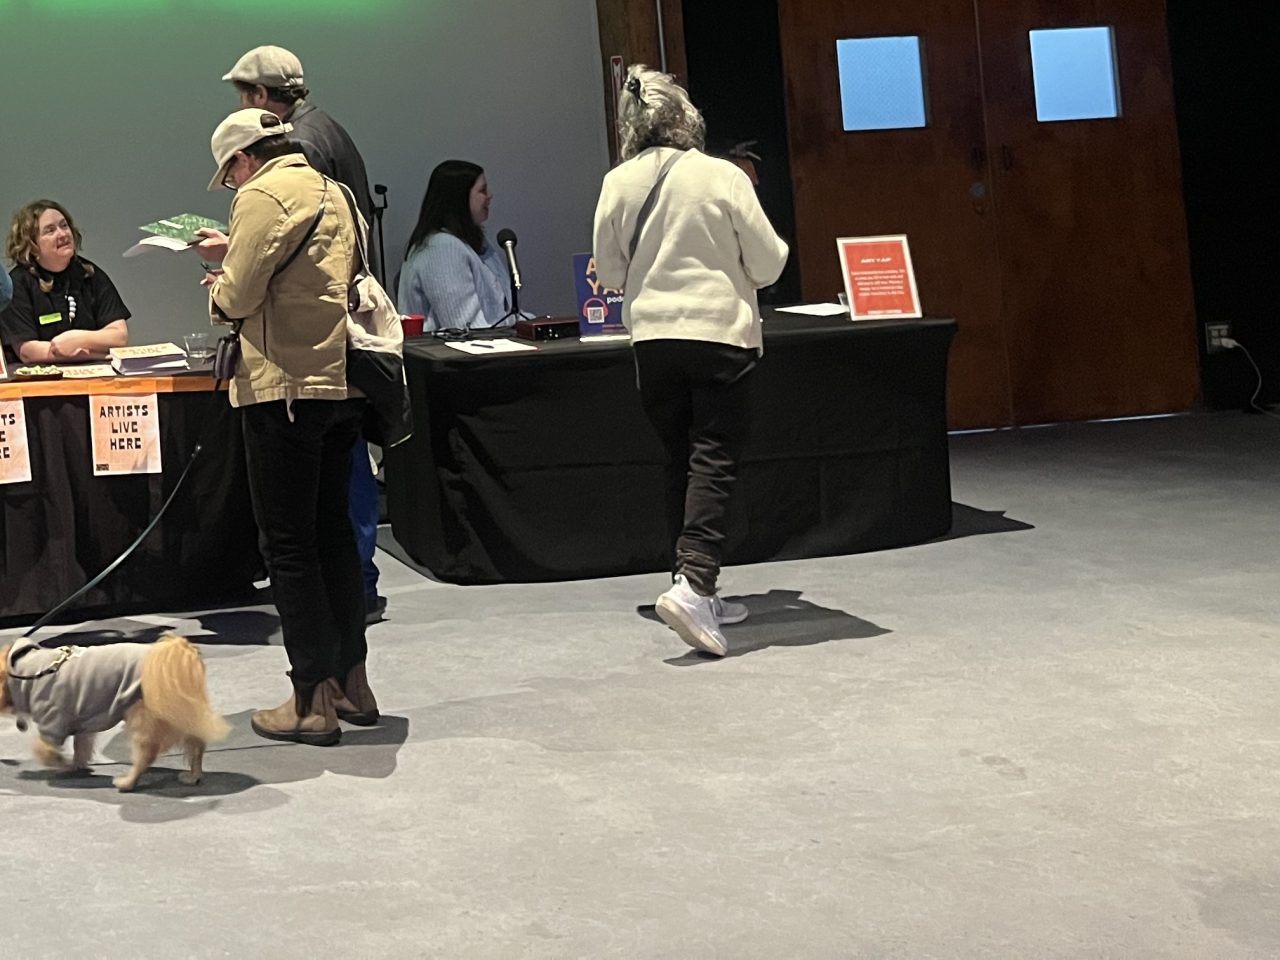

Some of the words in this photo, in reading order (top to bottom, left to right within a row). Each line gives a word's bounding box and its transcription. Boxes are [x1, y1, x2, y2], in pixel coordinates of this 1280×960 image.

[100, 405, 148, 418] ARTISTS
[111, 421, 139, 434] LIVE
[110, 437, 142, 451] HERE
